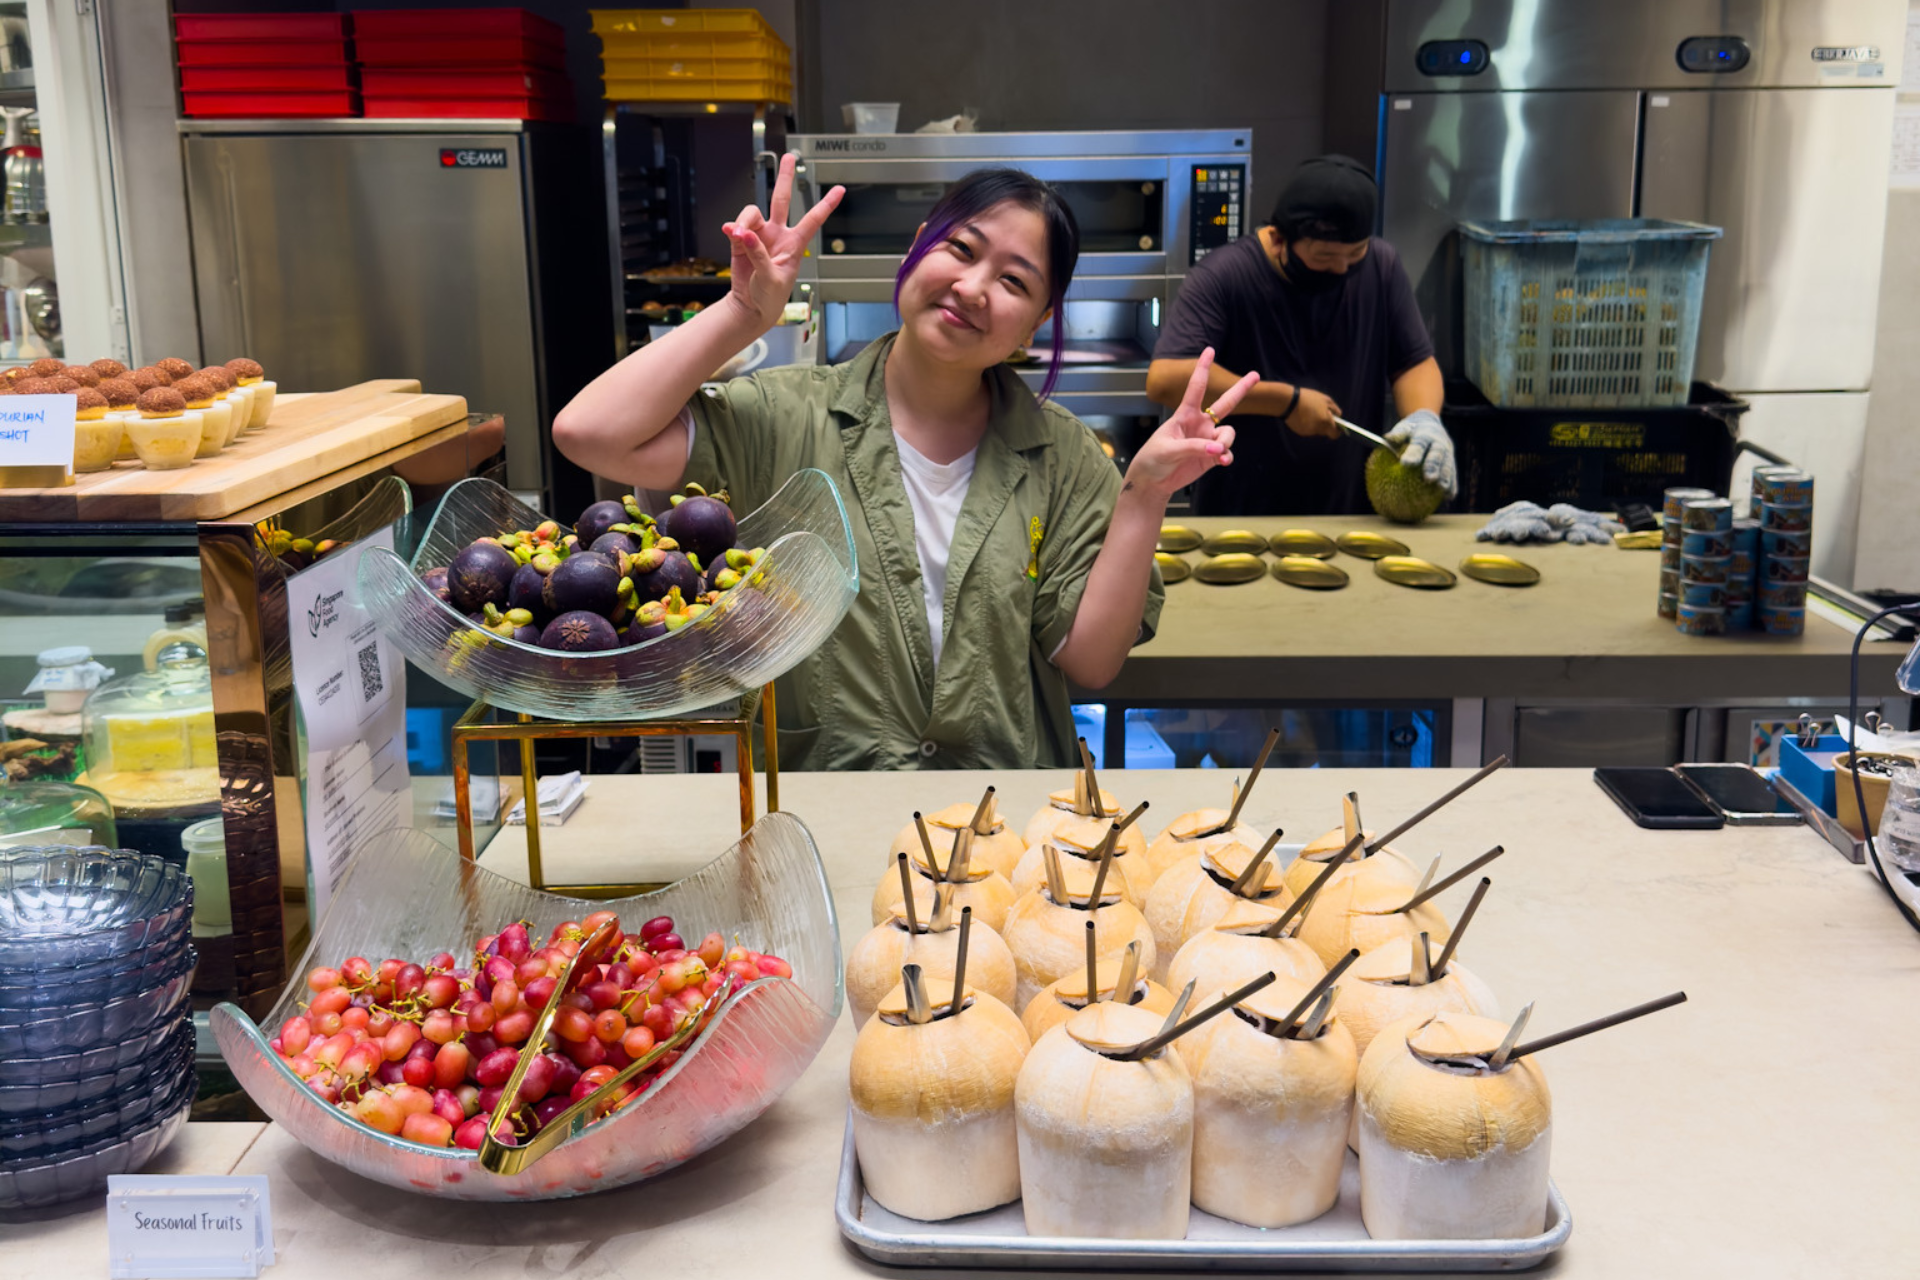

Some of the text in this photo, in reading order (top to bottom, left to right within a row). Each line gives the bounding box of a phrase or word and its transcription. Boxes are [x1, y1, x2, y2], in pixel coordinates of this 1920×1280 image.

[815, 140, 850, 151] MIWE
[322, 590, 344, 607] Singapore
[322, 605, 334, 616] Food
[323, 613, 339, 628] Agency
[134, 1211, 243, 1231] Seasonal Fruits
